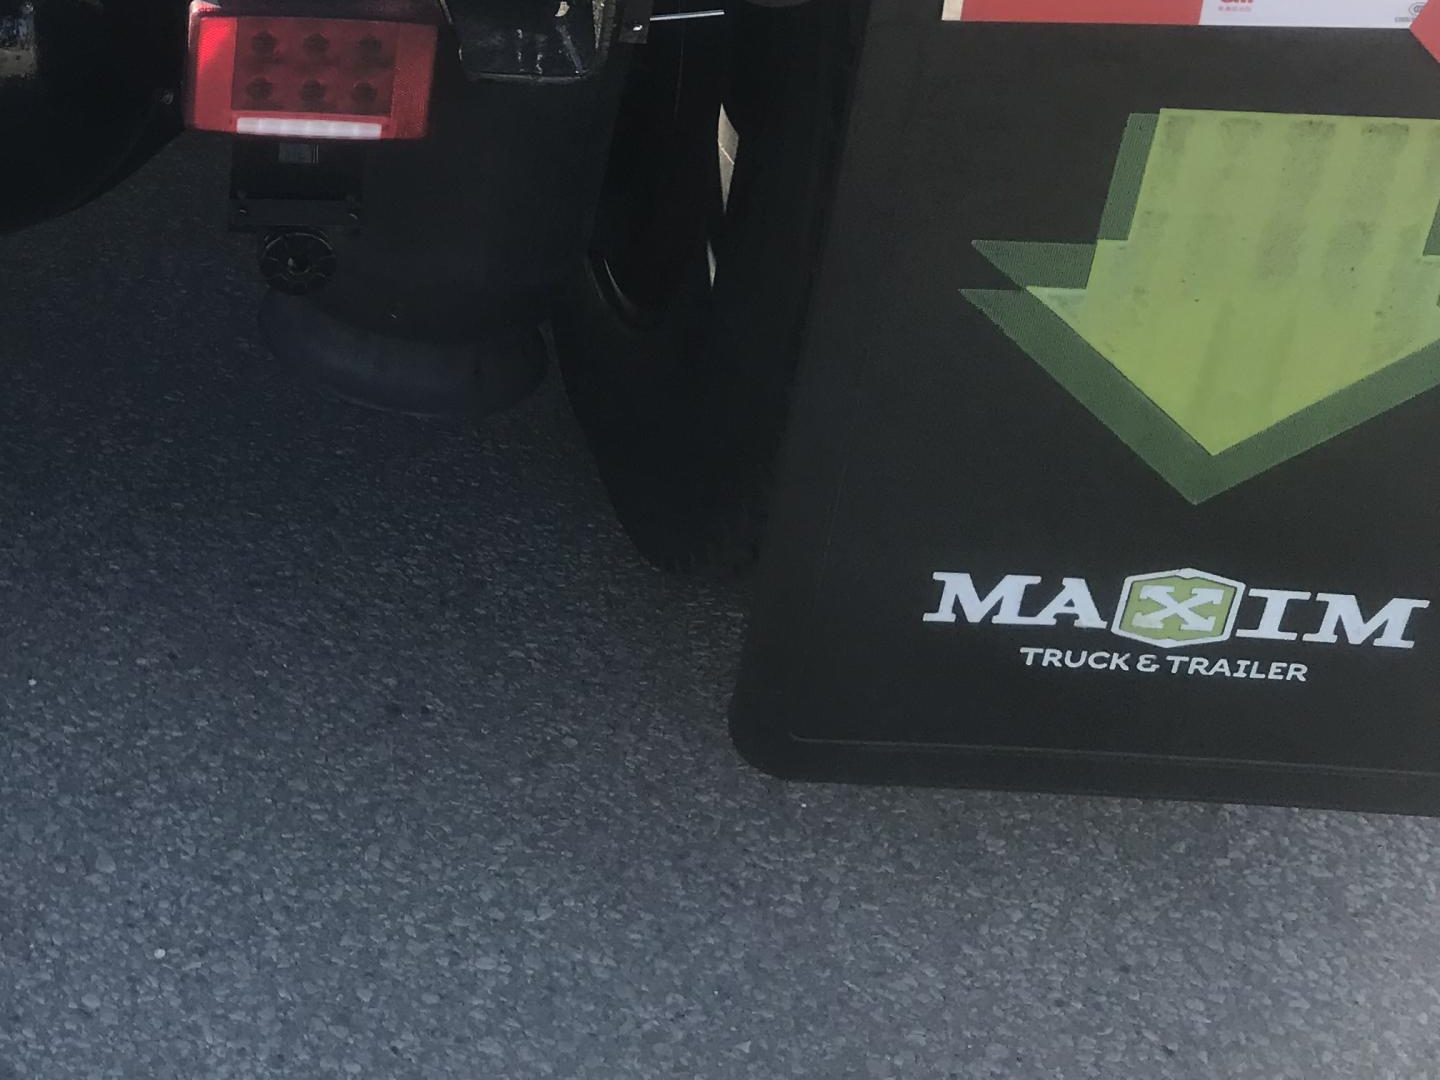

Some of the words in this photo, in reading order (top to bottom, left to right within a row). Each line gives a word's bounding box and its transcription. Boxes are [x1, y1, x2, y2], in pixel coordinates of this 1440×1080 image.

[922, 570, 1431, 649] MAXIM
[1019, 646, 1131, 671] TRUCK
[1136, 653, 1161, 673] &
[1165, 655, 1308, 682] TRAILER
